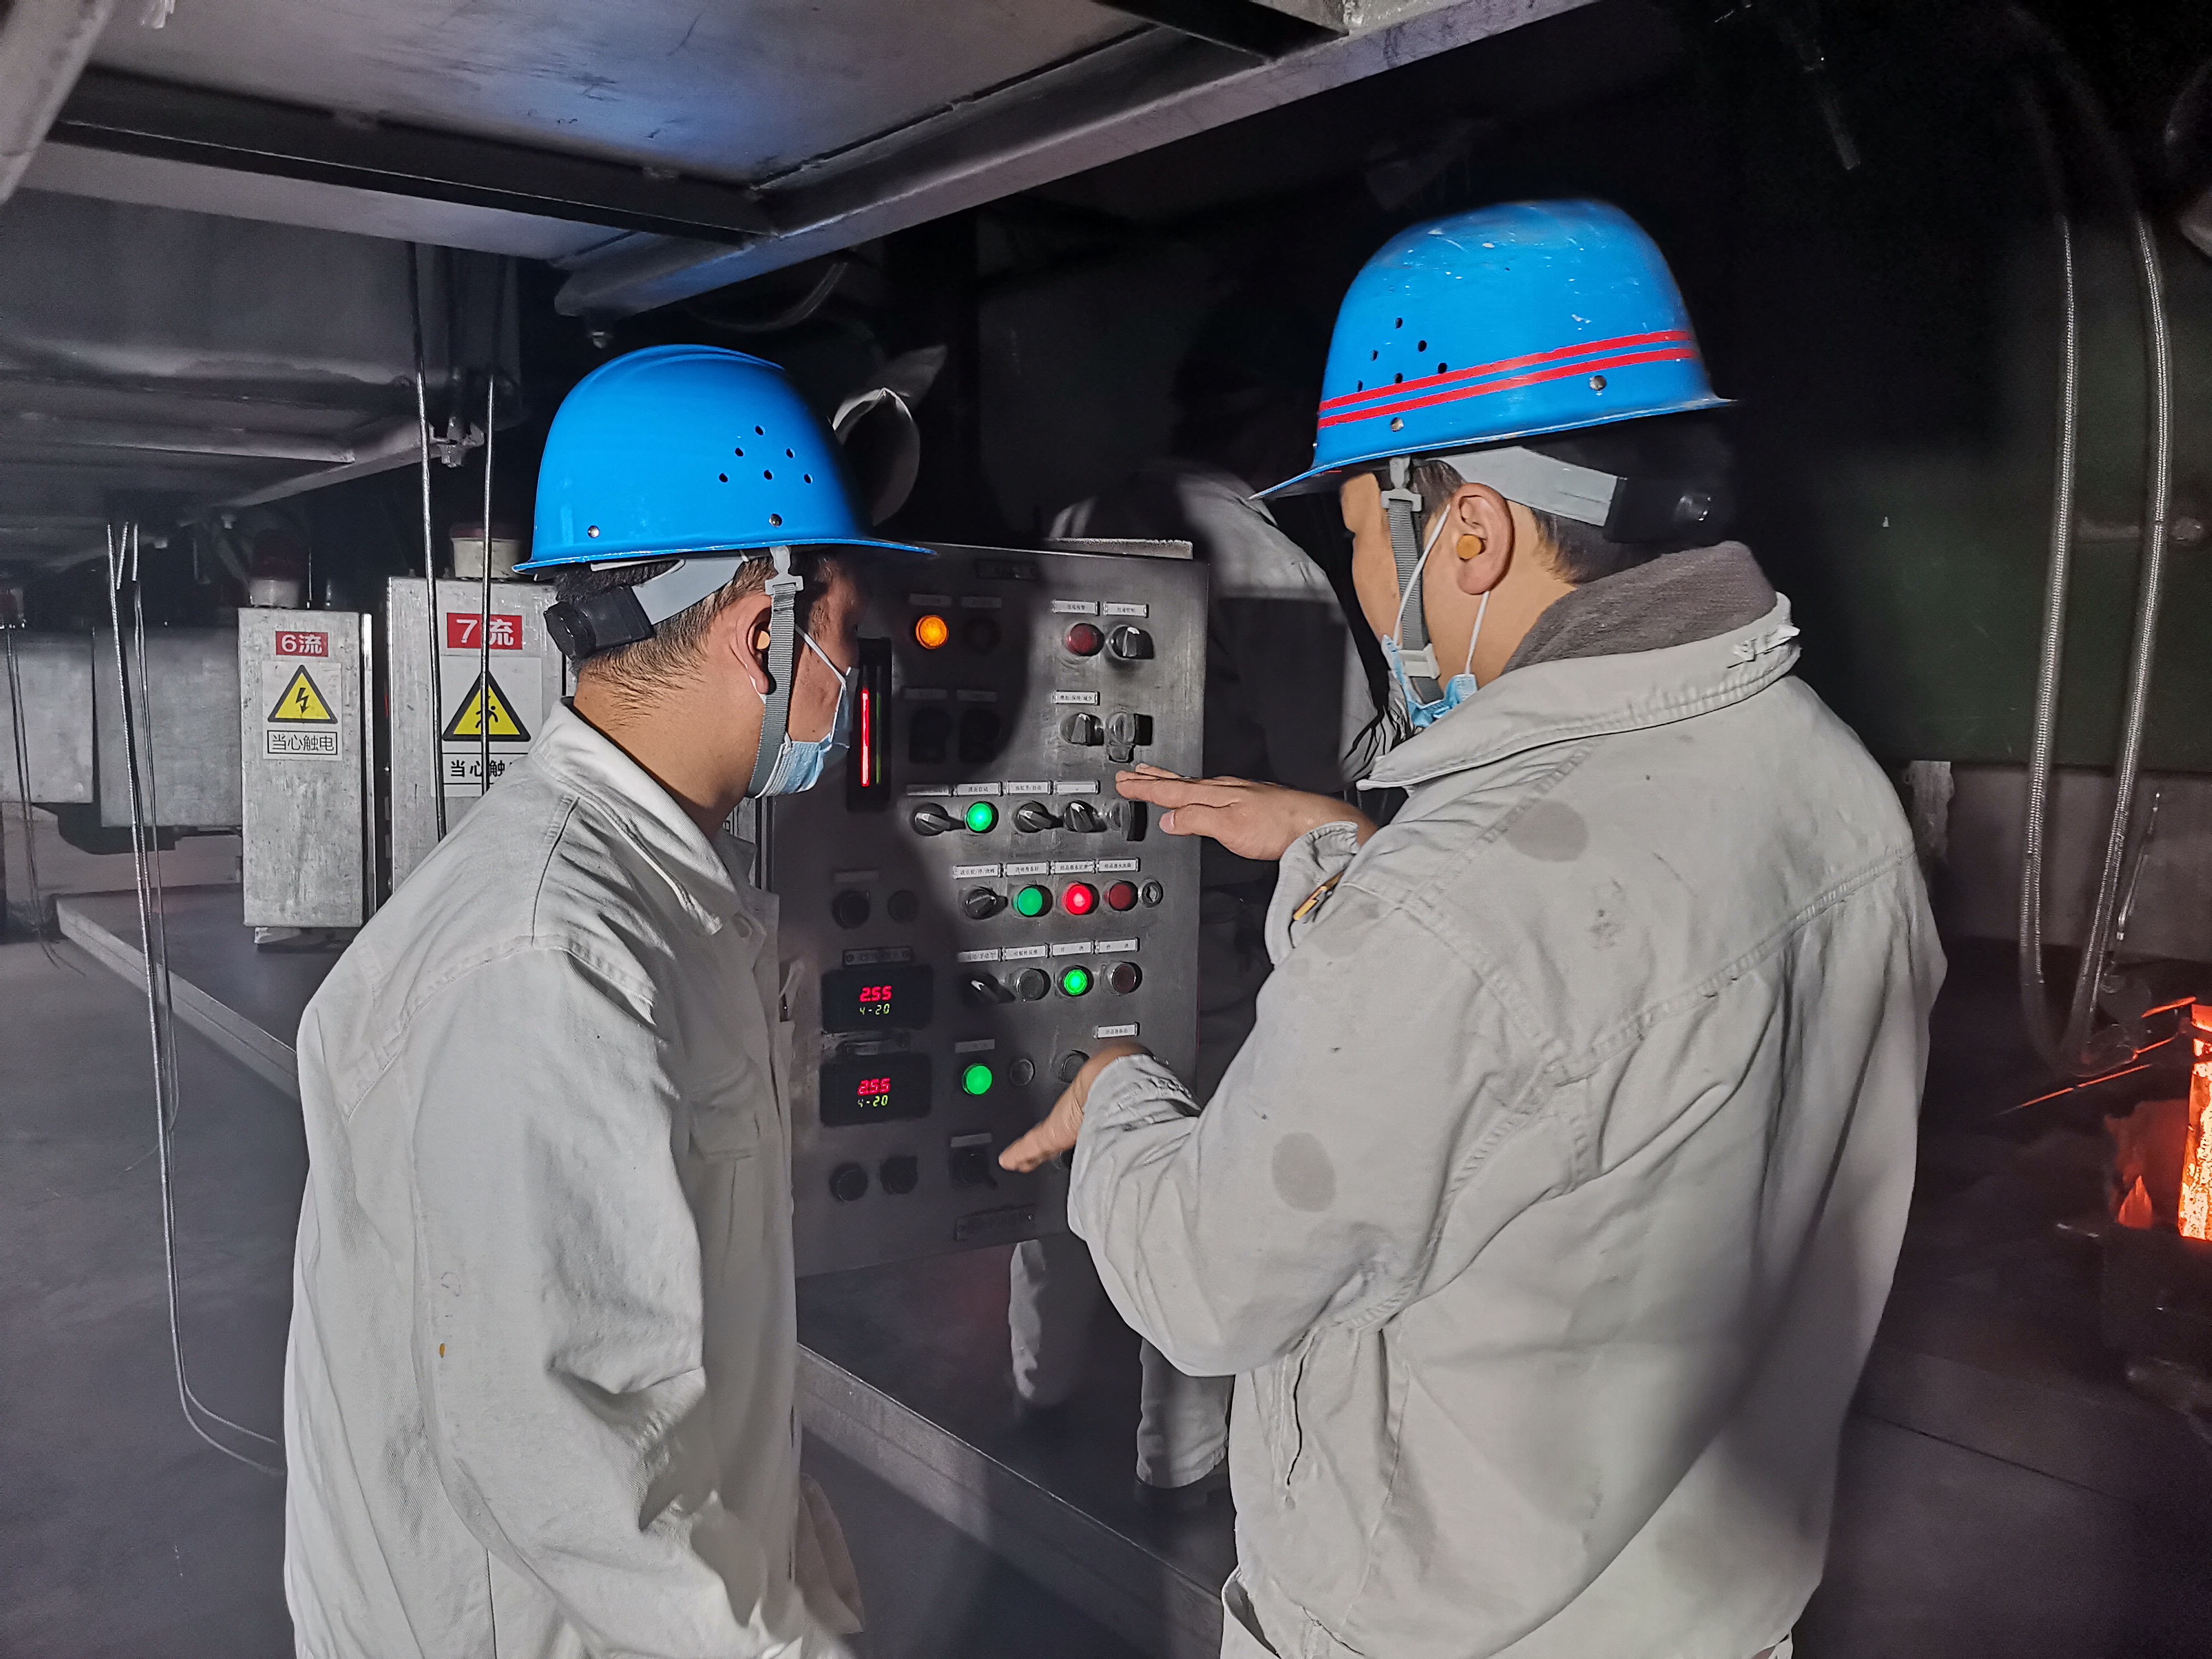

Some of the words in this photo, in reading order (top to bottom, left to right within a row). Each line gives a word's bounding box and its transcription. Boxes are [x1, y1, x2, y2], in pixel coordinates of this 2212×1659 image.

[281, 634, 322, 654] 6流
[272, 734, 334, 752] 当心触电
[451, 759, 512, 778] 当心触
